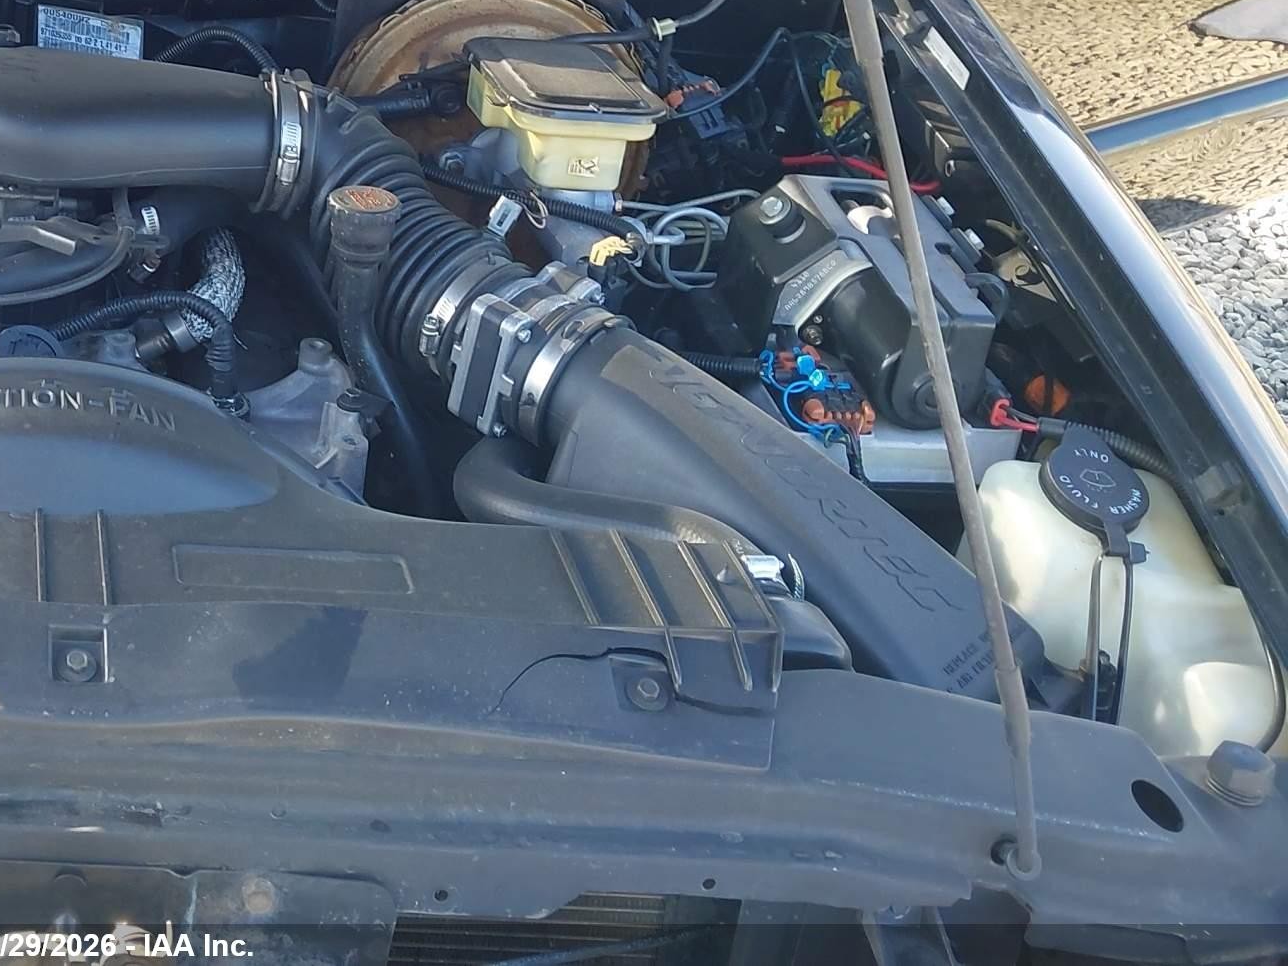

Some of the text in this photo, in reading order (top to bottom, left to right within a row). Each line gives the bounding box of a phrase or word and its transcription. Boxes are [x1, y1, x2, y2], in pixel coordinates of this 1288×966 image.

[1059, 448, 1142, 515] WASHER FLUID ONLY
